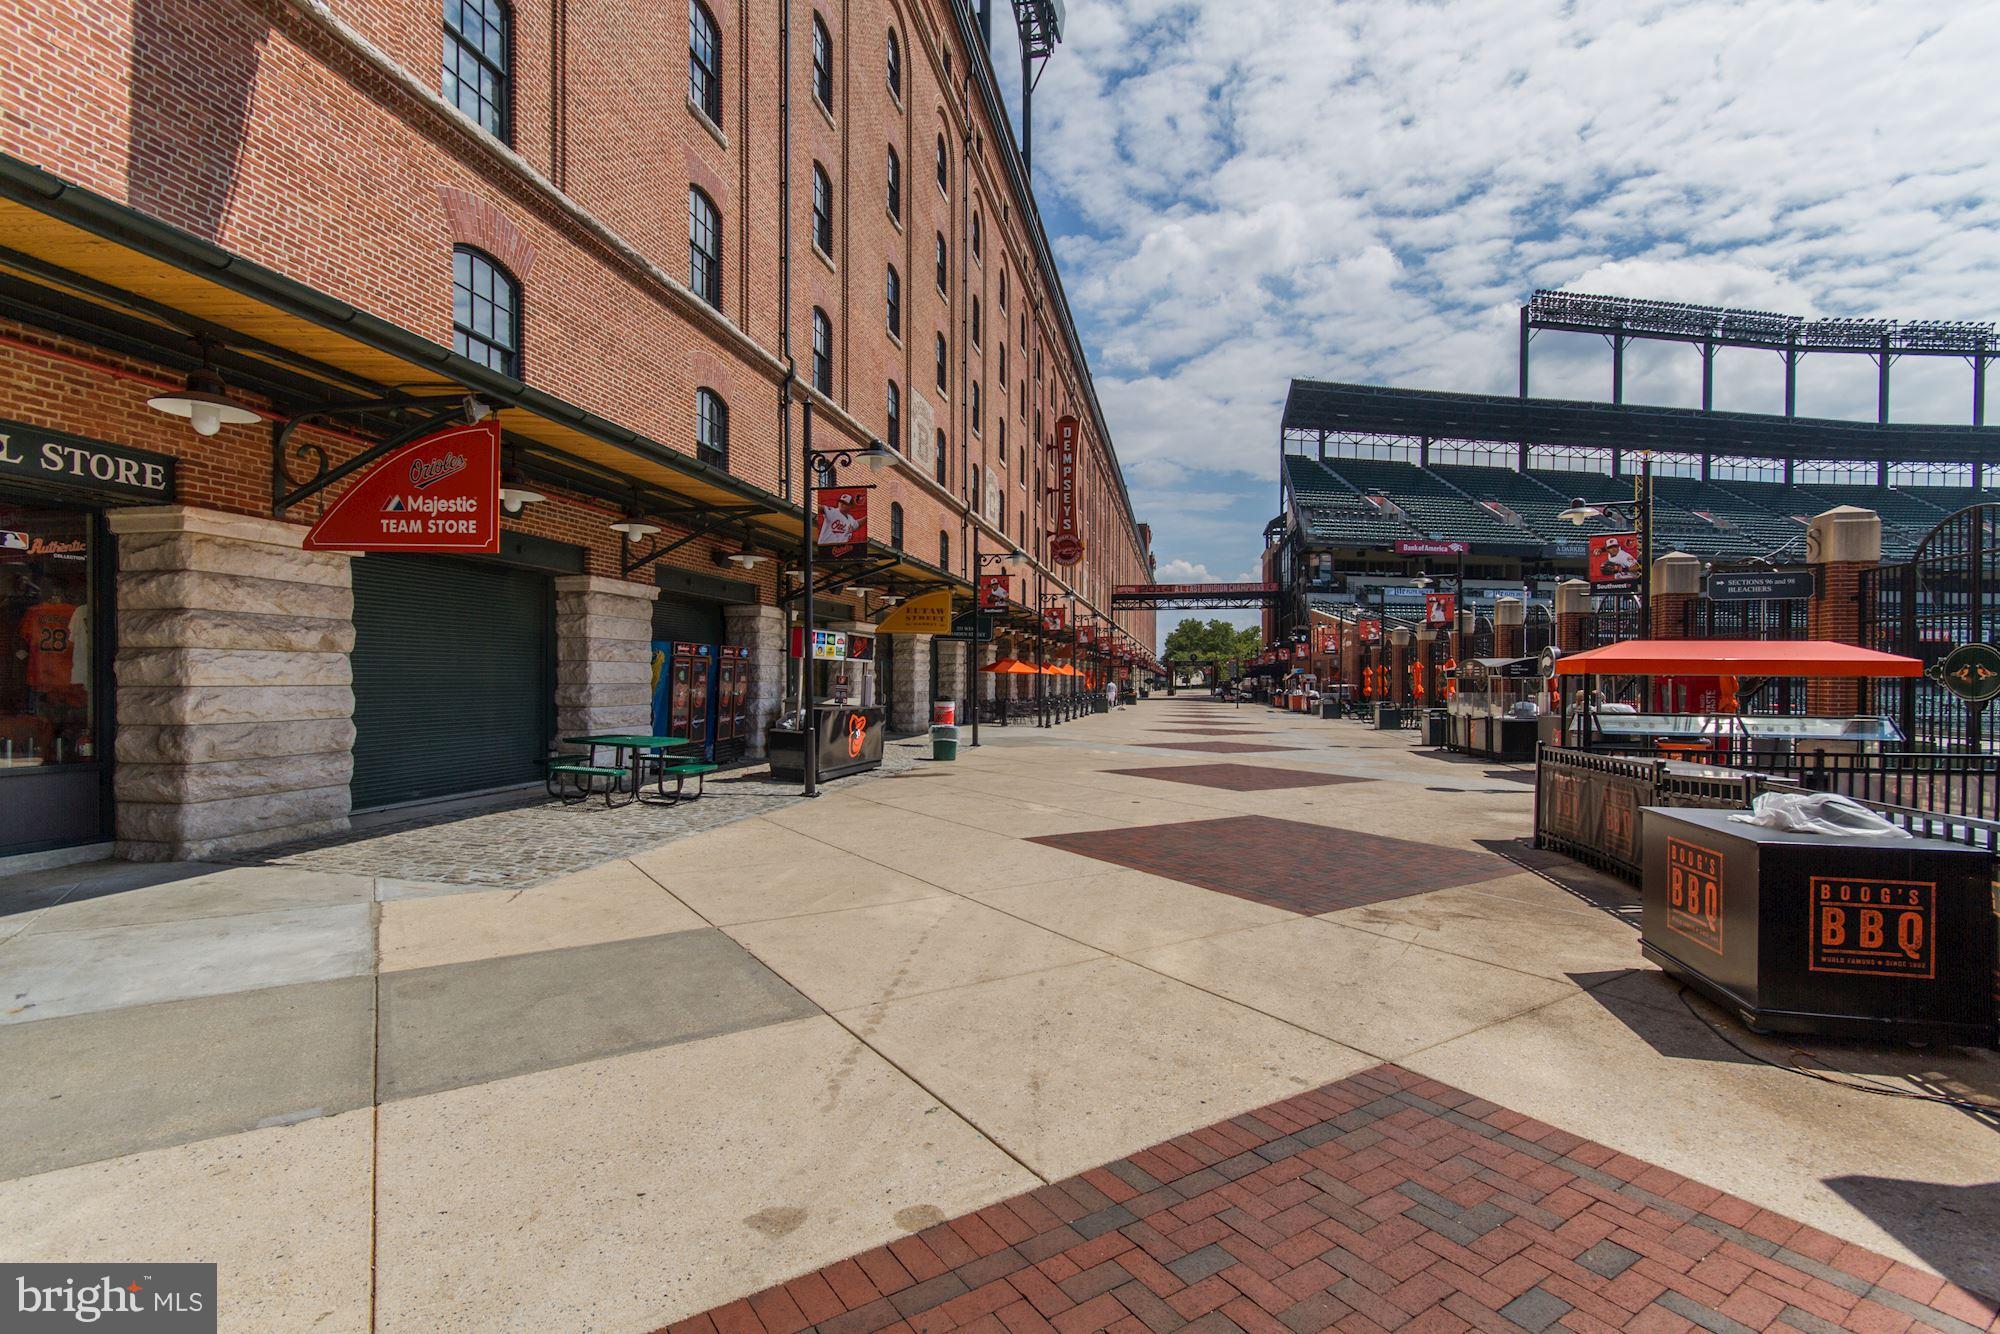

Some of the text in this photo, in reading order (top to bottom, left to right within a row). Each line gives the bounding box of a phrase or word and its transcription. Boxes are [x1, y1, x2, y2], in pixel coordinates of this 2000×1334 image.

[40, 443, 166, 490] STORE
[409, 452, 468, 490] Orioles
[1063, 427, 1072, 530] DEMPSEYS
[407, 495, 478, 517] Majestic
[381, 519, 477, 534] TEAM STORE
[27, 538, 86, 554] Authentic
[1728, 585, 1772, 593] BLEACHERS
[905, 607, 945, 615] EUTAW
[40, 627, 67, 653] 28
[1671, 844, 1715, 876] BOOG'S
[1672, 867, 1717, 932] BBQ
[1820, 883, 1919, 906] BOOG'S
[1821, 906, 1924, 960] BBQ
